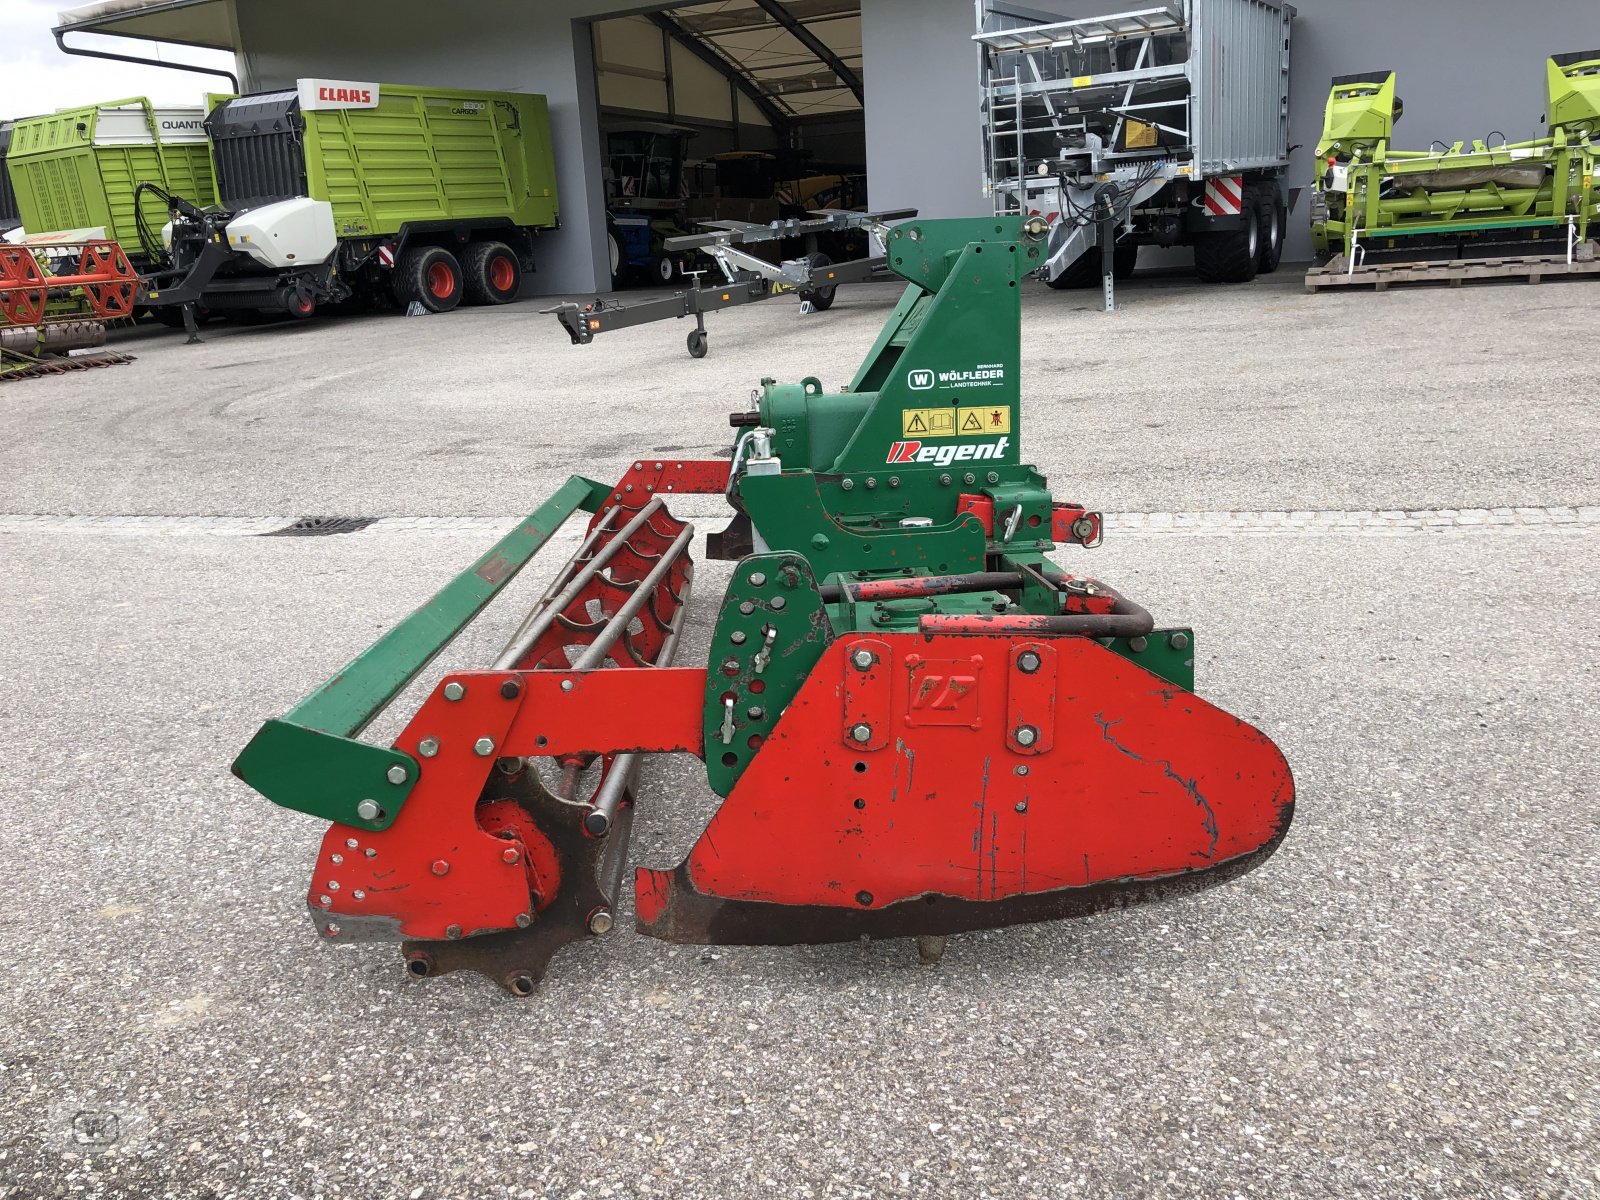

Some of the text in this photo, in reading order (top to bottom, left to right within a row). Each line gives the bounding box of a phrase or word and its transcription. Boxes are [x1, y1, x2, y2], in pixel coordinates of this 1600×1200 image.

[319, 87, 371, 103] CLAAS
[938, 370, 1004, 382] WÖLFLEDER
[950, 380, 992, 388] LANDTECHNIK
[885, 436, 1010, 467] Regent
